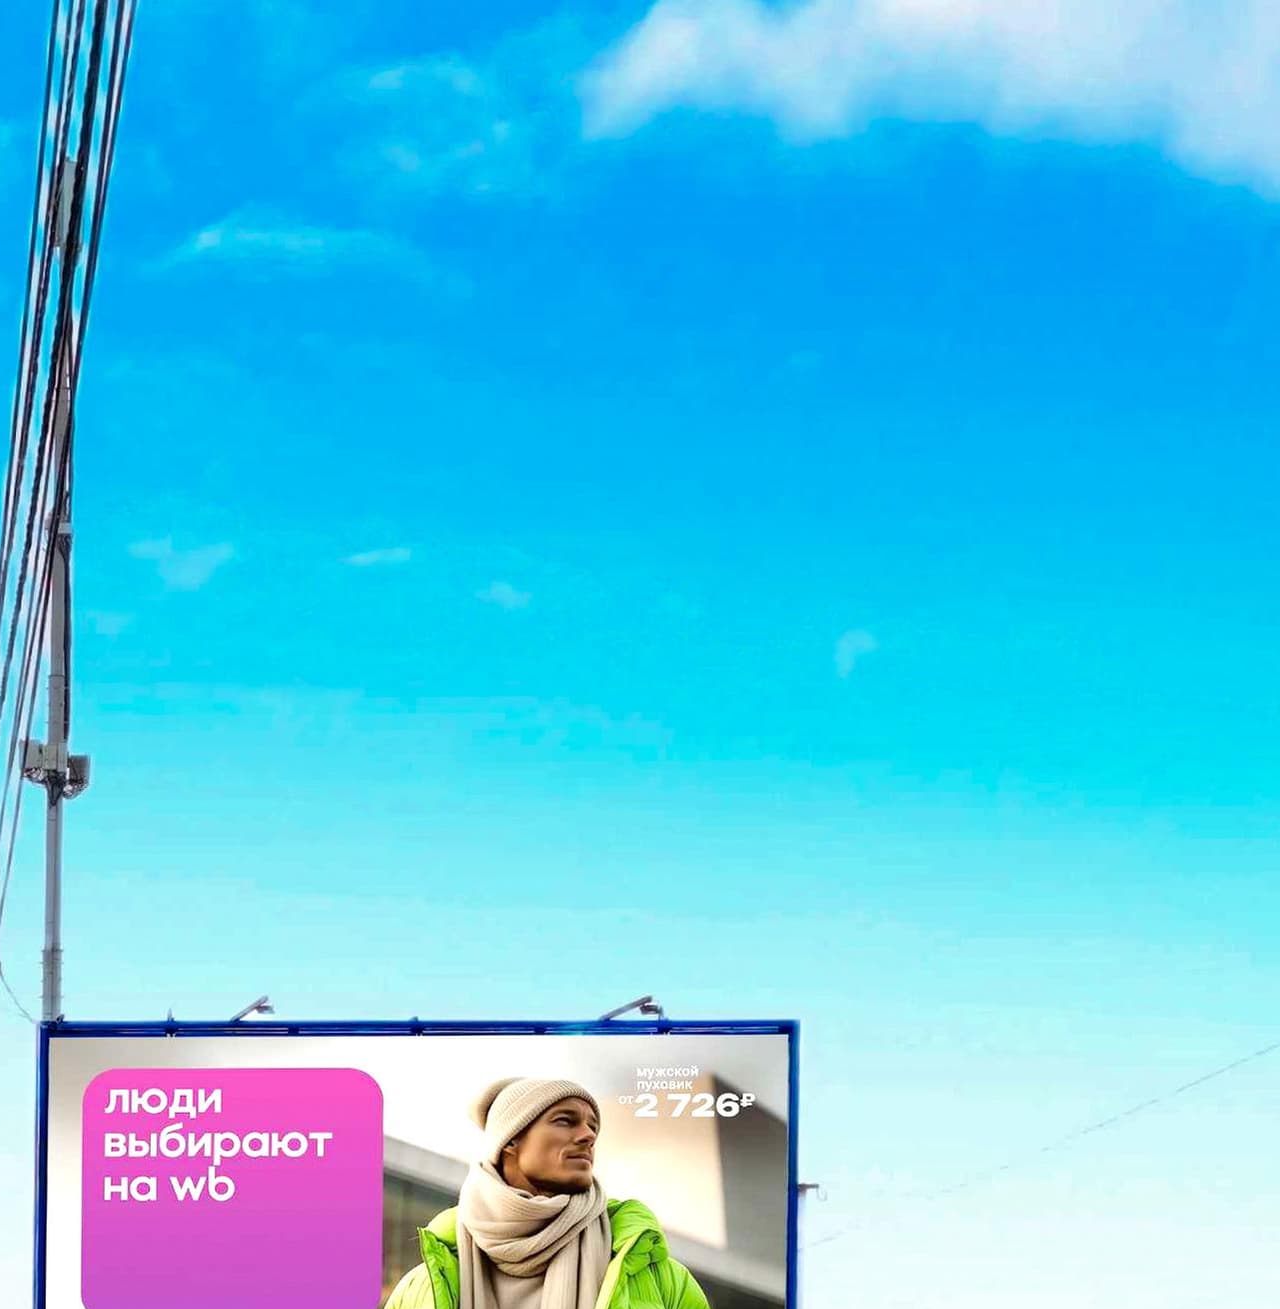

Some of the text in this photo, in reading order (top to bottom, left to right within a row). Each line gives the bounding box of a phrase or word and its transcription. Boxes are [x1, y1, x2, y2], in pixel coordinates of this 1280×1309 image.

[636, 1065, 699, 1079] мужской
[636, 1080, 693, 1092] пуховик
[103, 1088, 223, 1119] люди
[618, 1095, 634, 1105] от
[103, 1122, 334, 1166] выбирают
[103, 1166, 236, 1202] на wb
